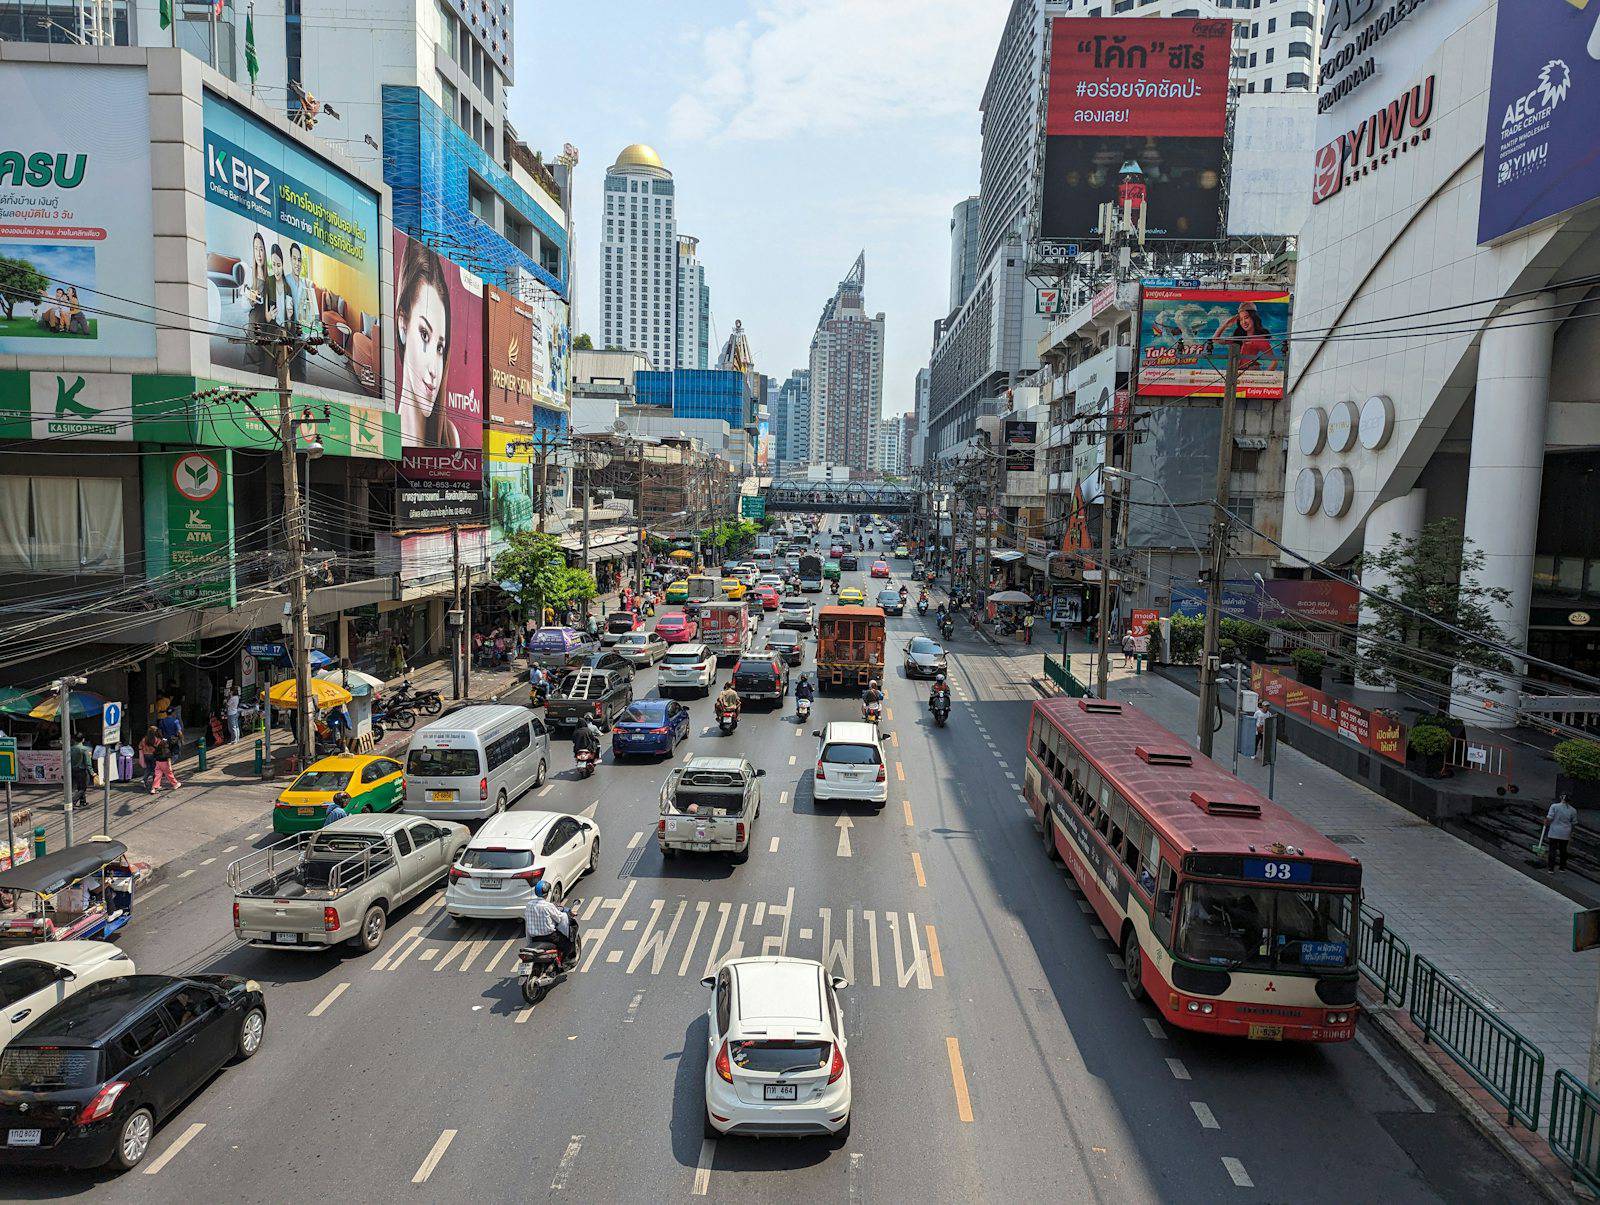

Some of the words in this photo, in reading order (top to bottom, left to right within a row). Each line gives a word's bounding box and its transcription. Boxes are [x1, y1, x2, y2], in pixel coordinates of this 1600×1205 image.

[1167, 43, 1205, 70] ซีโร่
[1319, 43, 1355, 86] FOOD
[1317, 57, 1376, 114] PRATUNAM
[1073, 108, 1130, 123] ลองเลย!
[1501, 89, 1537, 129] AEC
[1346, 75, 1435, 167] YIWU
[1501, 122, 1523, 140] TRADE
[1523, 106, 1552, 129] CENTER
[1519, 121, 1551, 142] WHOLESALE
[1344, 127, 1431, 186] SELECTION
[1513, 142, 1548, 170] YIWU
[207, 143, 229, 184] K
[231, 156, 272, 205] BIZ
[209, 181, 229, 198] Online
[229, 189, 251, 210] Banking
[251, 199, 272, 218] Platform
[52, 210, 59, 219] 3
[61, 209, 74, 220] วัน
[1042, 245, 1067, 256] Plan
[1068, 245, 1077, 255] B
[1145, 346, 1175, 359] Take
[448, 391, 480, 414] NITIPON
[402, 454, 477, 471] NITIPON
[410, 480, 422, 488] Tel.
[423, 481, 471, 489] 02-653-4742
[186, 531, 213, 542] ATM
[273, 645, 281, 653] 17
[1264, 862, 1291, 880] 93
